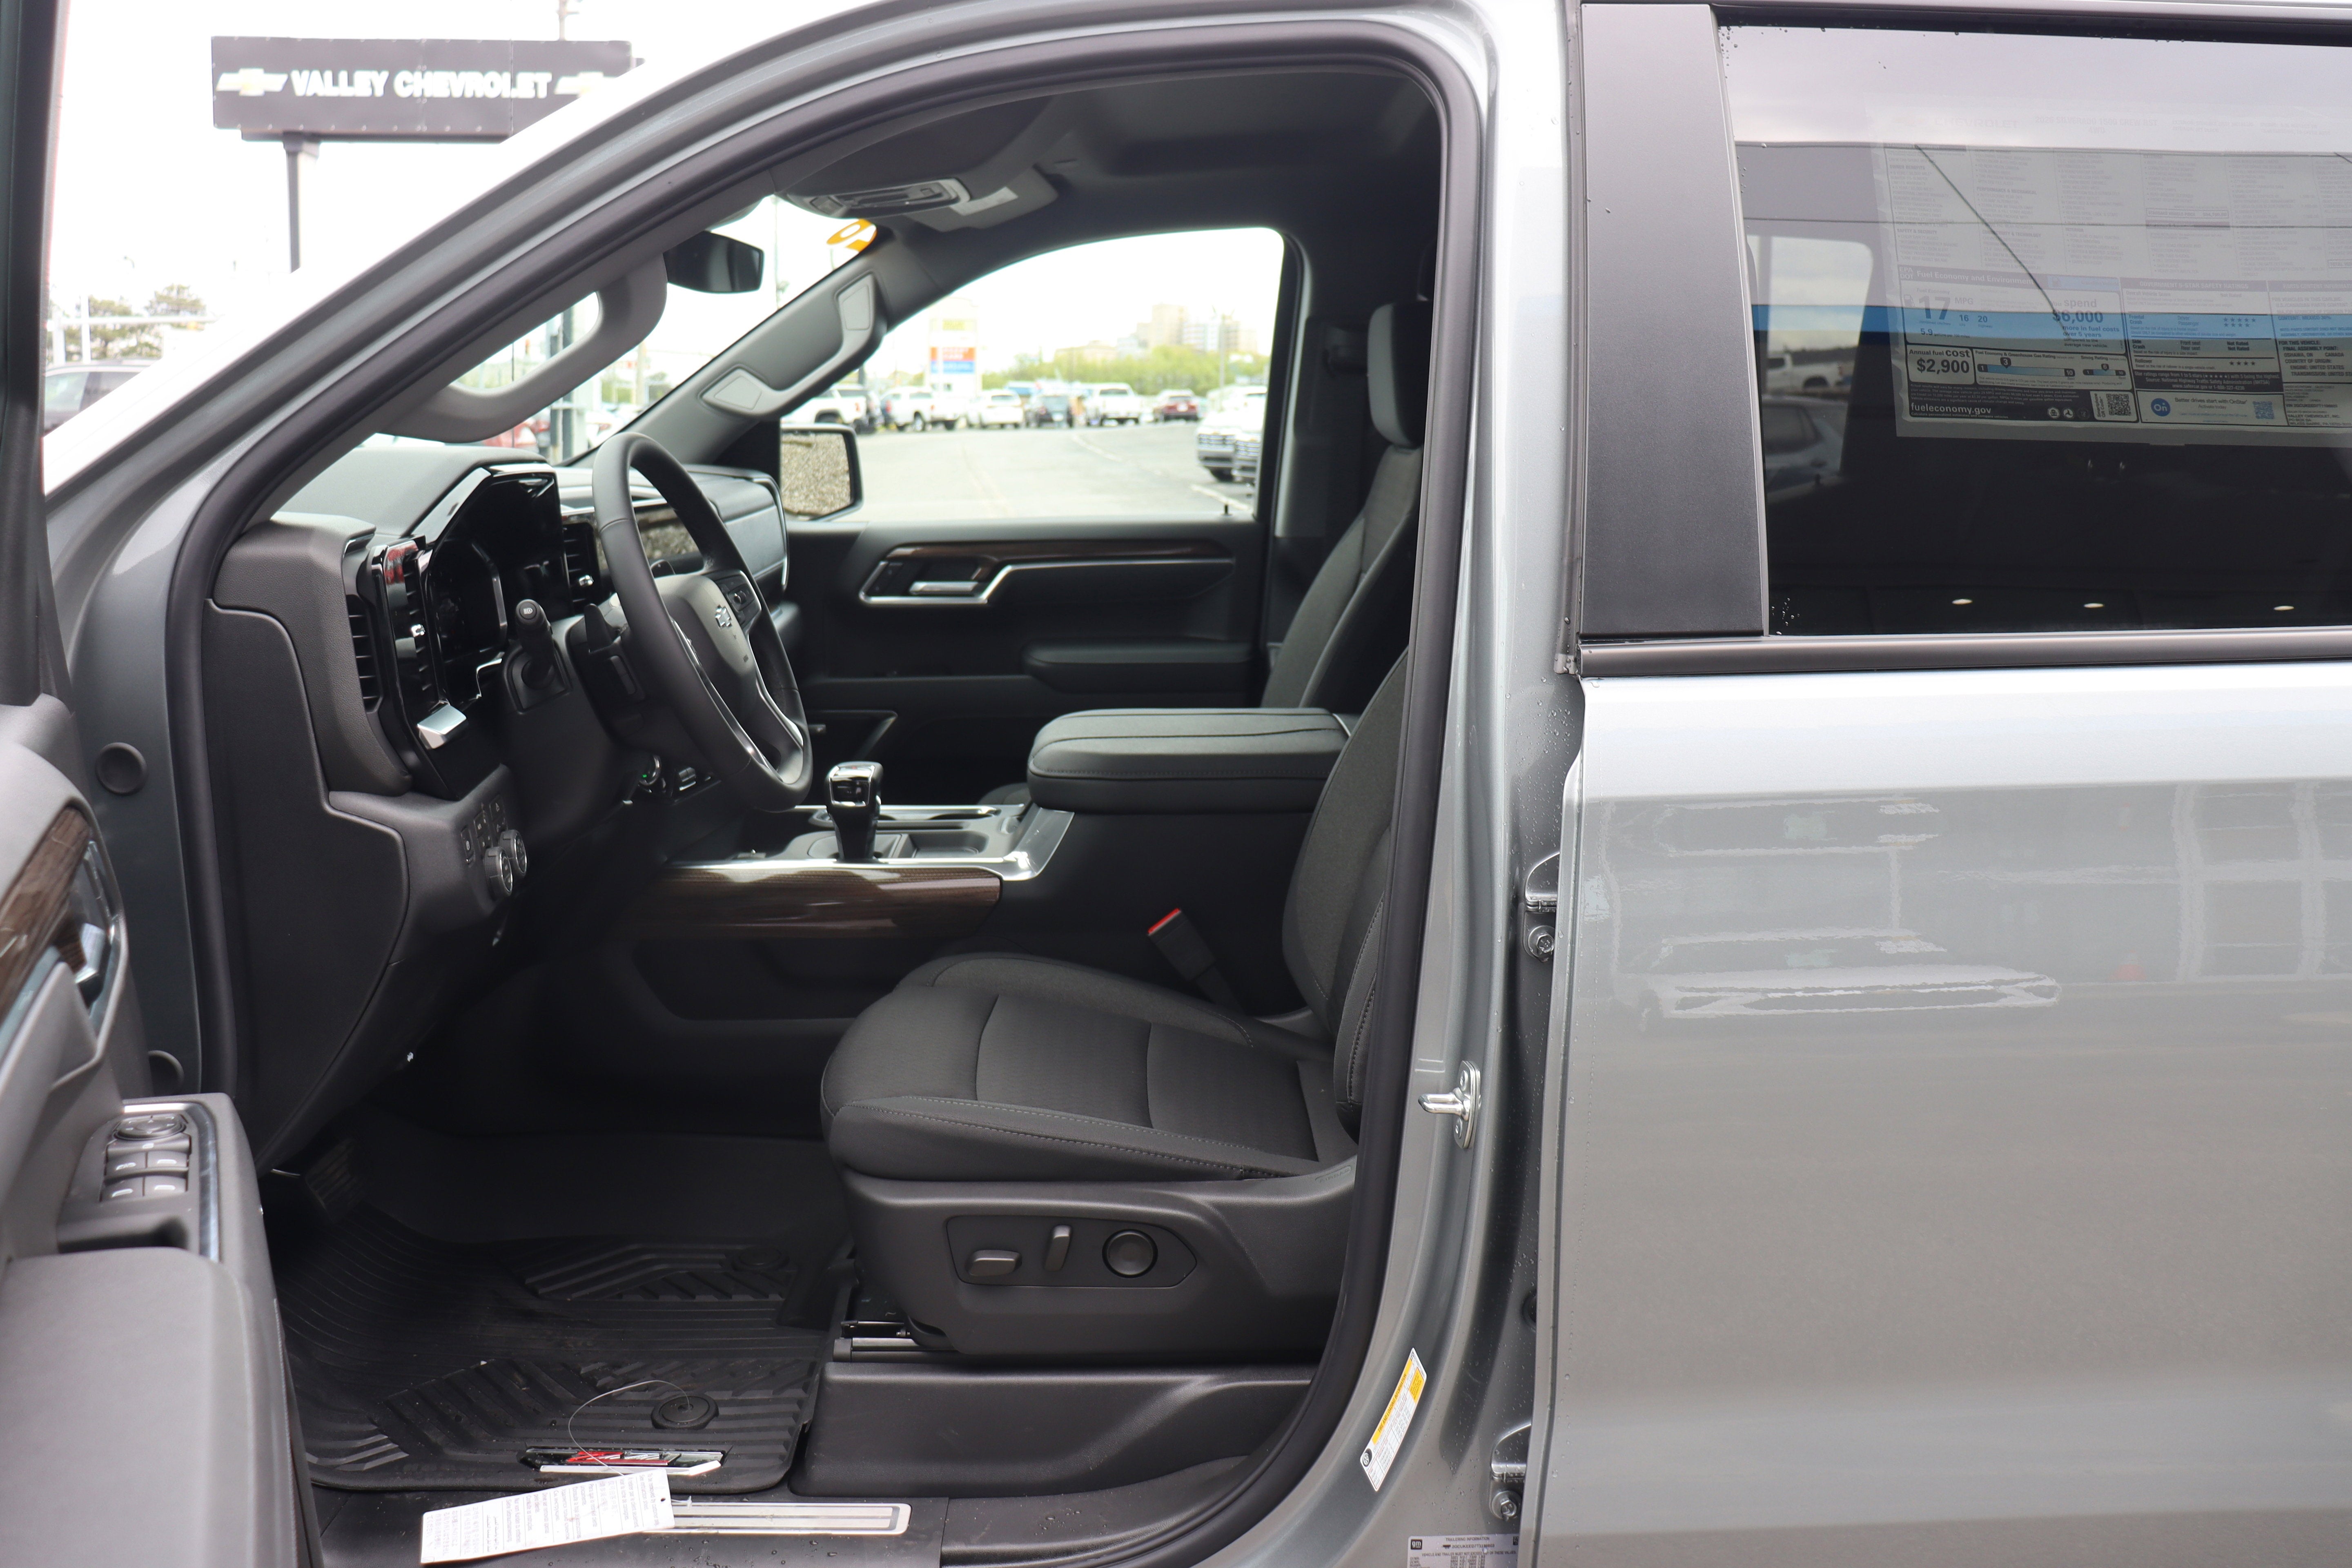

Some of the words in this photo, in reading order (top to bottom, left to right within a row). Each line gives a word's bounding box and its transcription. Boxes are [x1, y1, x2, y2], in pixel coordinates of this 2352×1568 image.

[291, 69, 389, 97] VALLEY
[394, 71, 552, 99] CHEVROLET
[1917, 270, 1933, 278] Fuel
[1934, 271, 1969, 281] Economy
[1955, 296, 1974, 305] MPG
[2064, 298, 2097, 308] spend
[1919, 295, 1951, 321] 17
[1959, 314, 1969, 322] 16
[1977, 315, 1988, 323] 20
[2053, 310, 2103, 324] $6,000
[1920, 327, 1933, 336] 5.9
[1945, 350, 1971, 358] cost
[1916, 358, 1970, 374] $2,900
[1911, 403, 1992, 415] fueleconomy.gov
[2154, 403, 2168, 412] On
[1387, 1398, 1396, 1416] LOADING
[1394, 1373, 1407, 1399] INFORMATION
